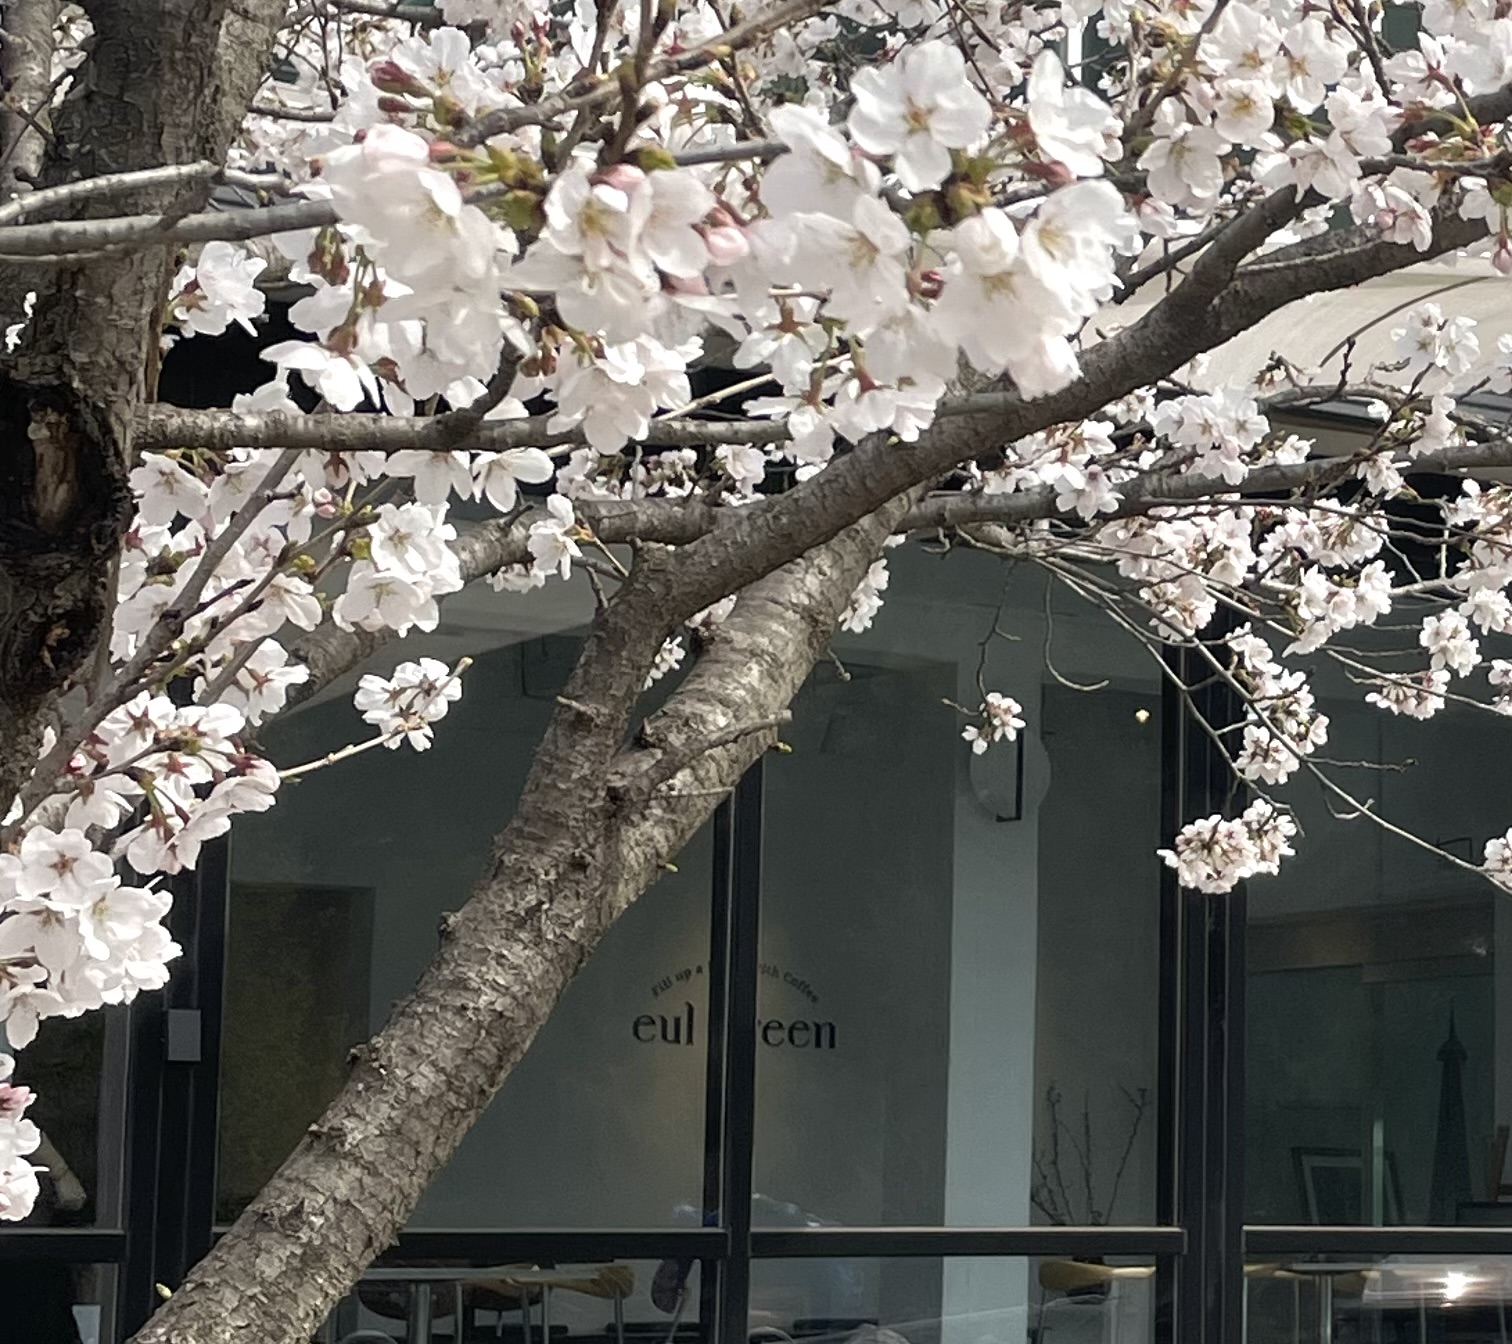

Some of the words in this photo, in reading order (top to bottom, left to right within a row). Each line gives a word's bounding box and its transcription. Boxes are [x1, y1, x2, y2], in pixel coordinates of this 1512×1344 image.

[675, 967, 692, 985] up
[632, 1001, 695, 1046] eul
[757, 1018, 837, 1050] een
